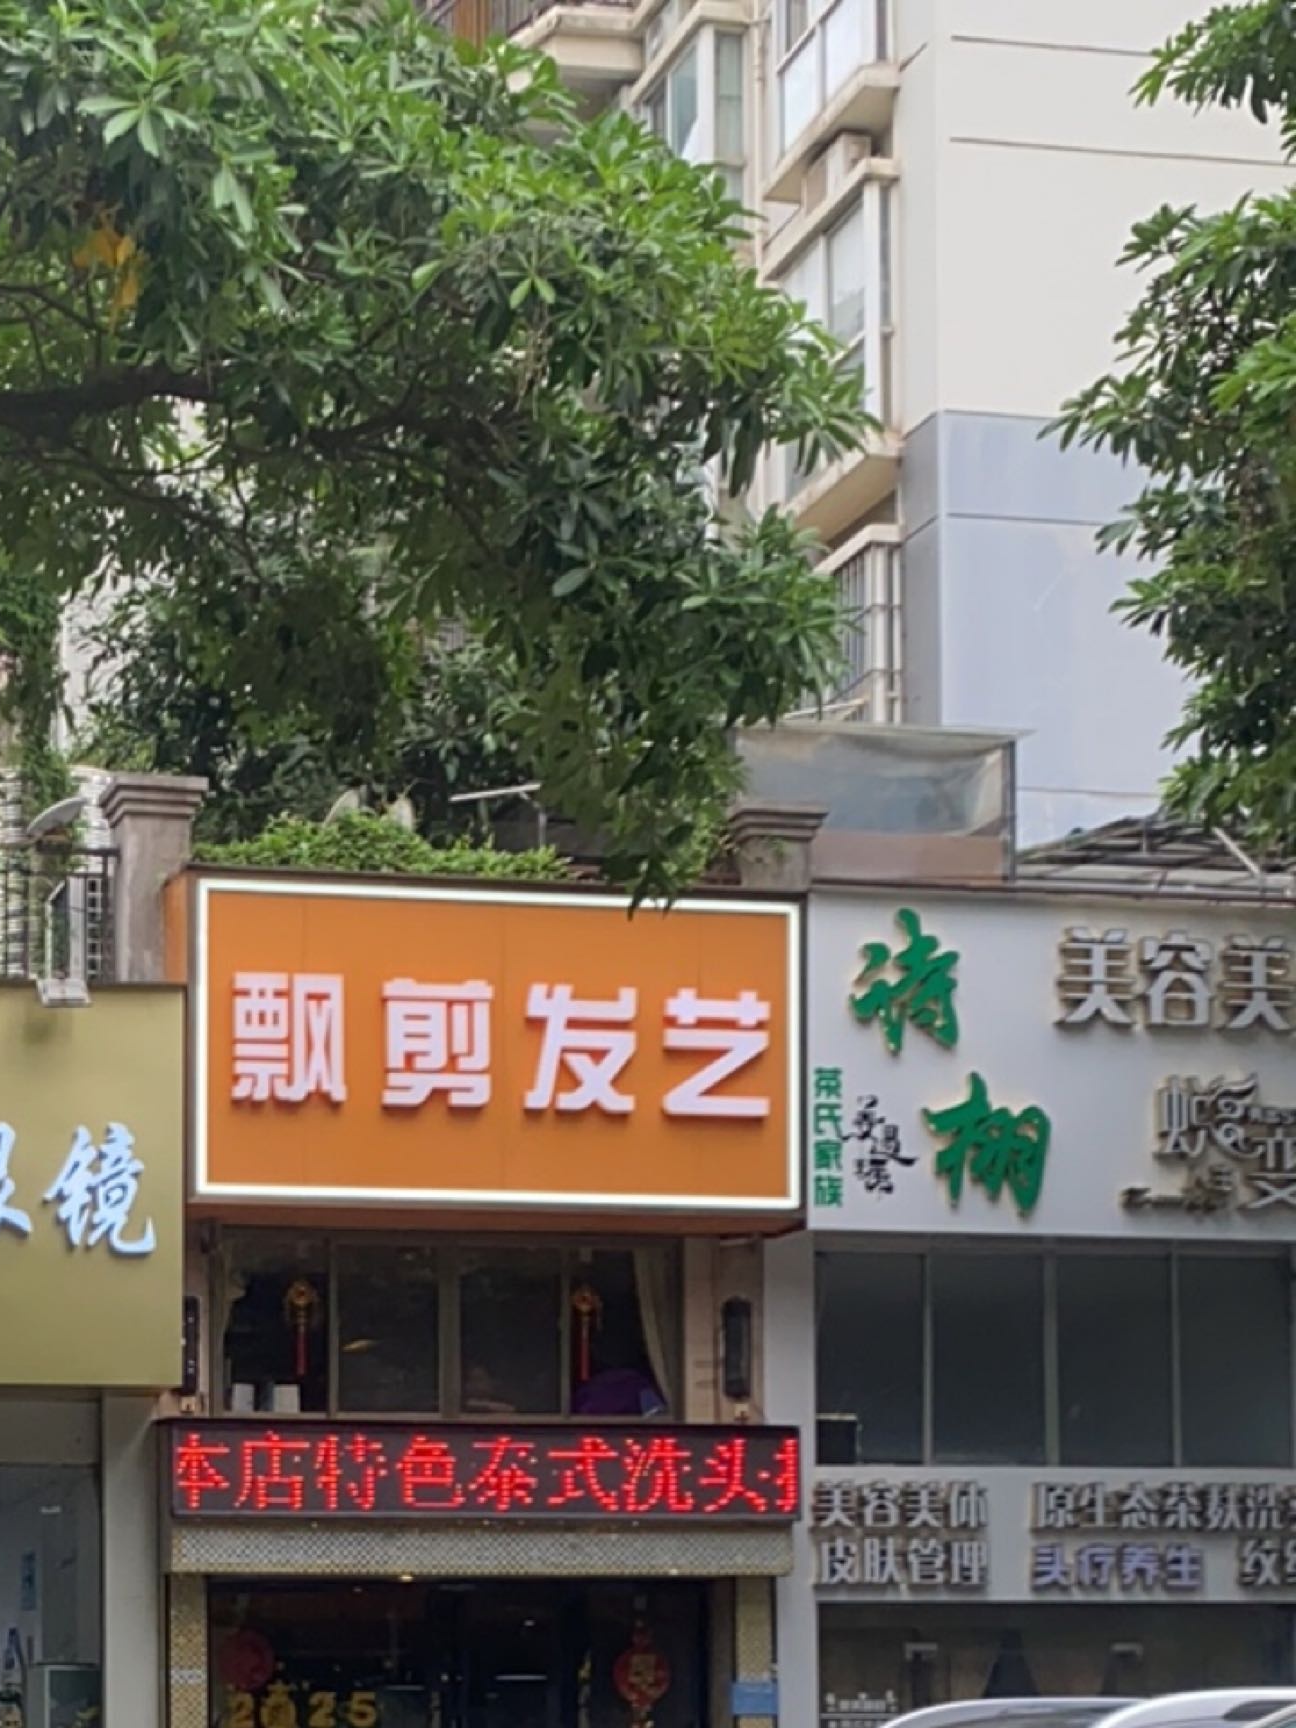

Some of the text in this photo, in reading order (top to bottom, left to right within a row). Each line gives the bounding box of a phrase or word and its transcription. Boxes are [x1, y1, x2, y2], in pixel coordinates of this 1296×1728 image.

[1054, 926, 1296, 1030] 美容美
[231, 971, 771, 1118] 飘剪发艺
[812, 1478, 989, 1529] 美容美体
[817, 1536, 989, 1587] 皮肤管理
[1032, 1542, 1203, 1588] 头疗养生
